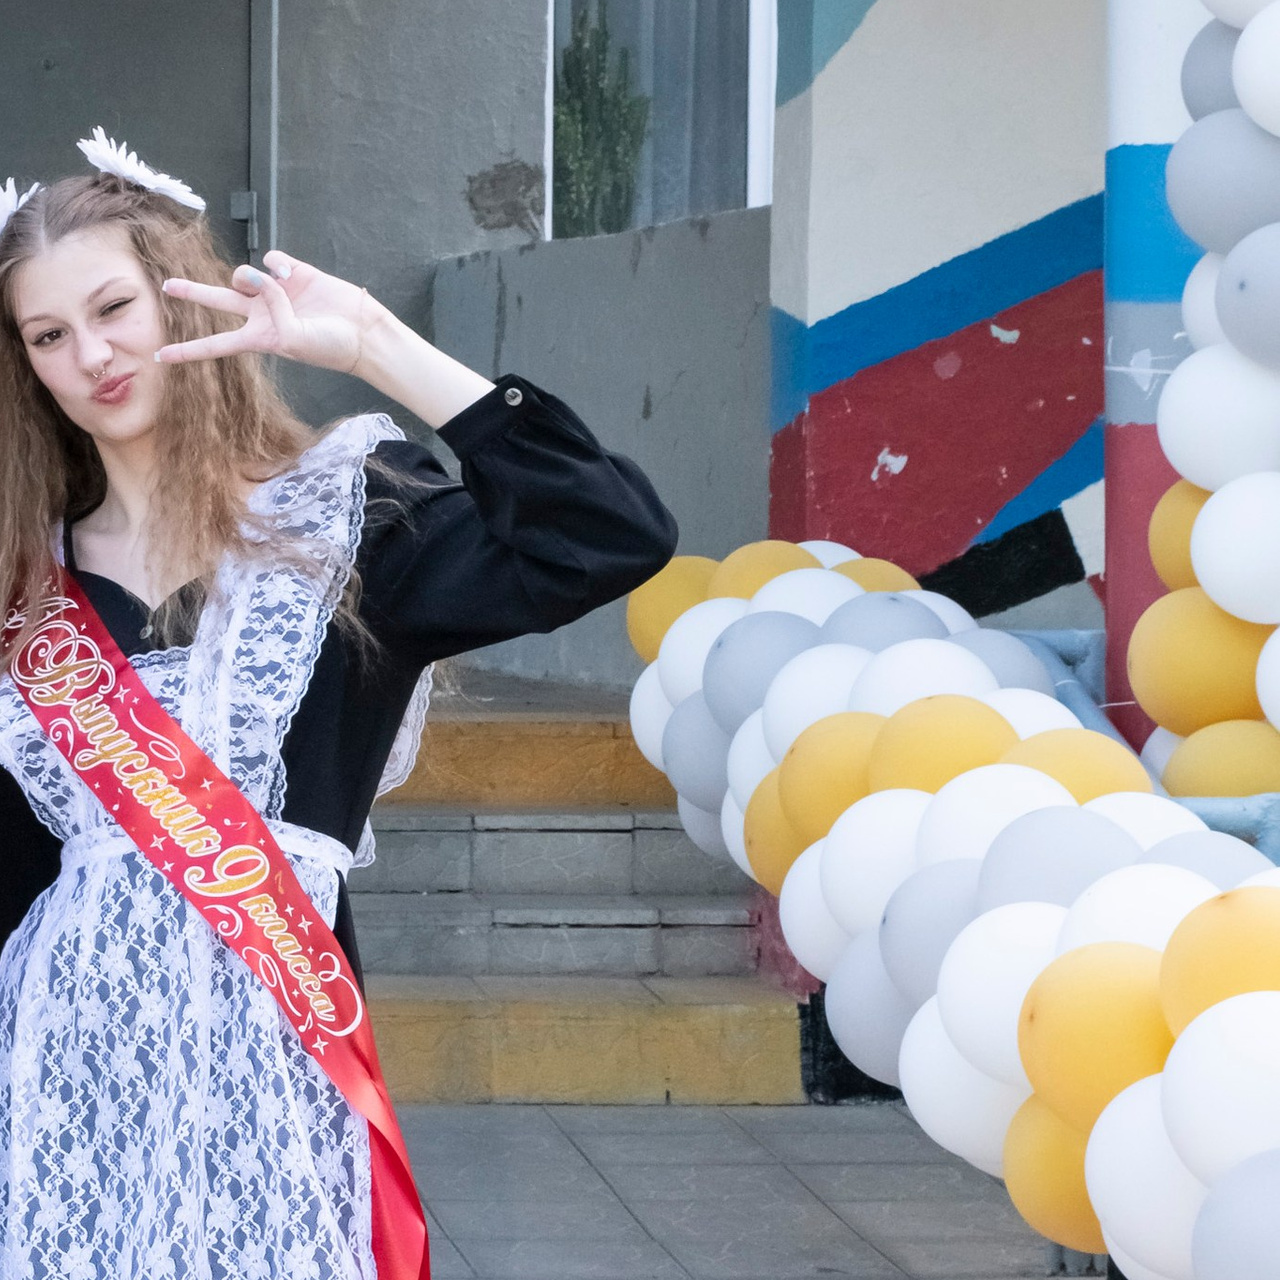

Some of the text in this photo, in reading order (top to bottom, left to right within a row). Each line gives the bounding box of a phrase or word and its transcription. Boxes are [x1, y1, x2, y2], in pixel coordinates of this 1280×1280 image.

[10, 618, 338, 1024] Выпускник 9 класса
